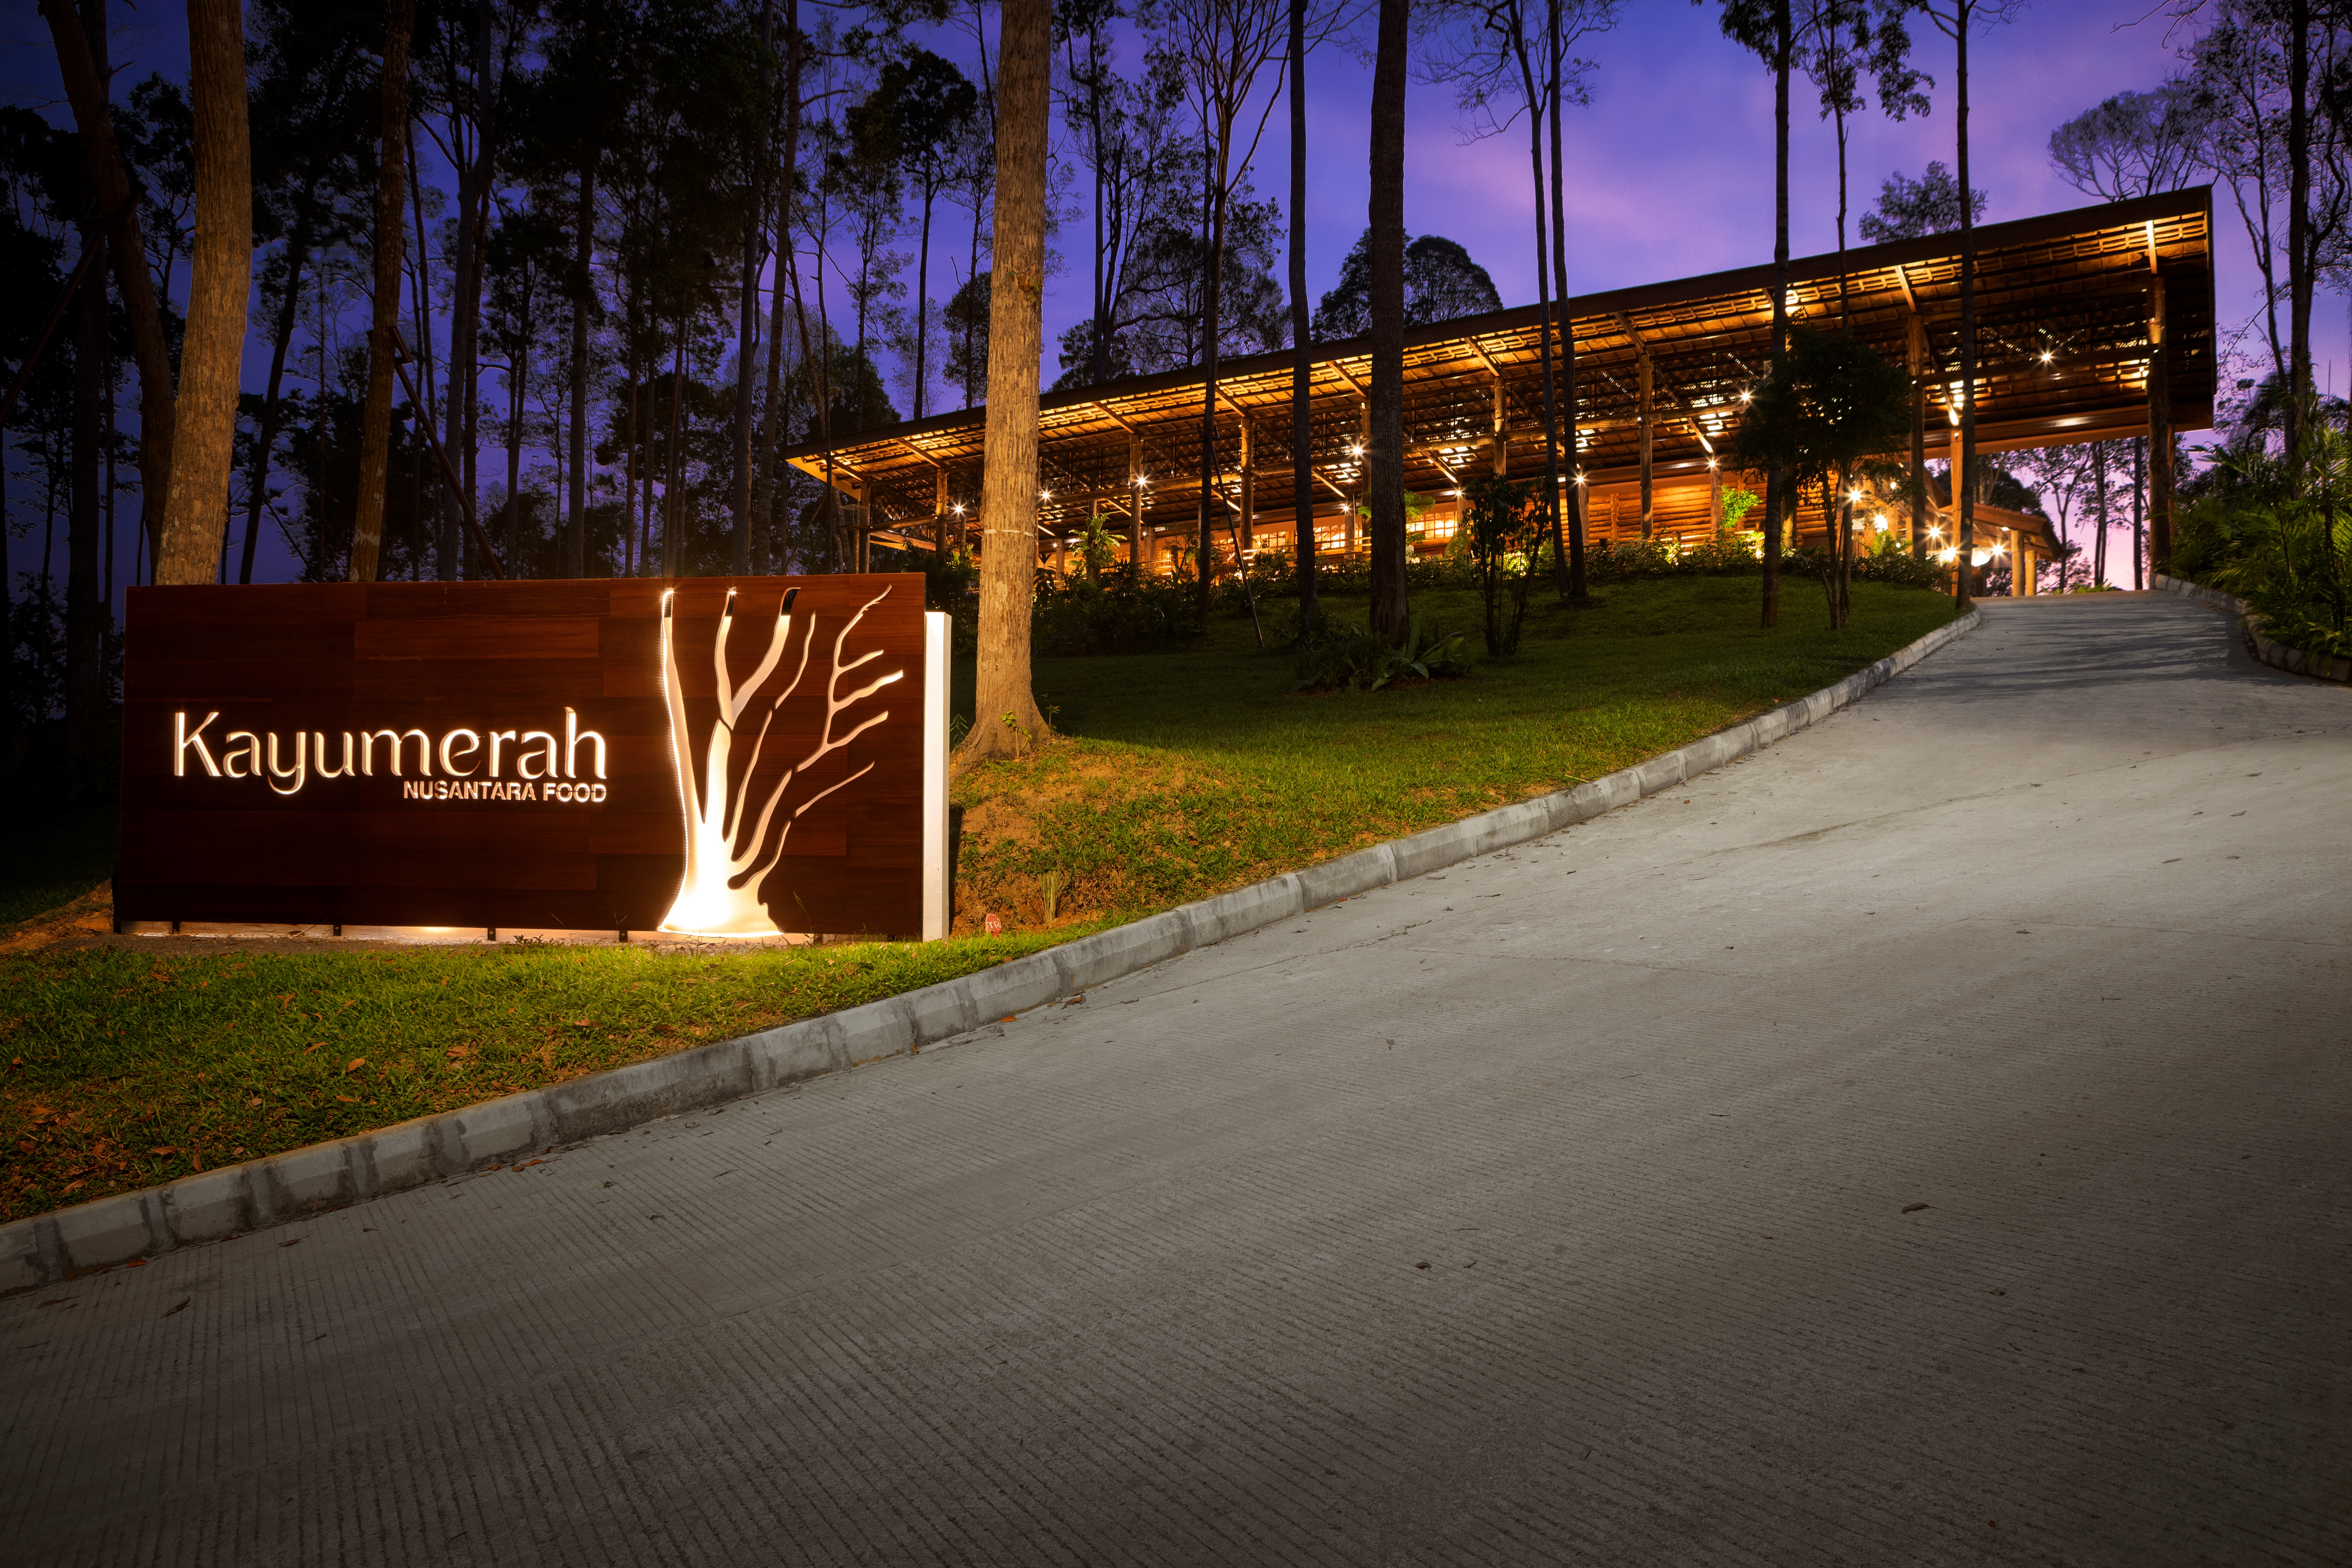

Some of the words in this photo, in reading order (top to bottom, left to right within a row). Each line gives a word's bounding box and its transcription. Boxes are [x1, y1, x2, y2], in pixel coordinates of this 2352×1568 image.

[174, 707, 607, 795] Kayumerah
[404, 781, 536, 801] NUSANTARA
[543, 782, 606, 802] FOOD
